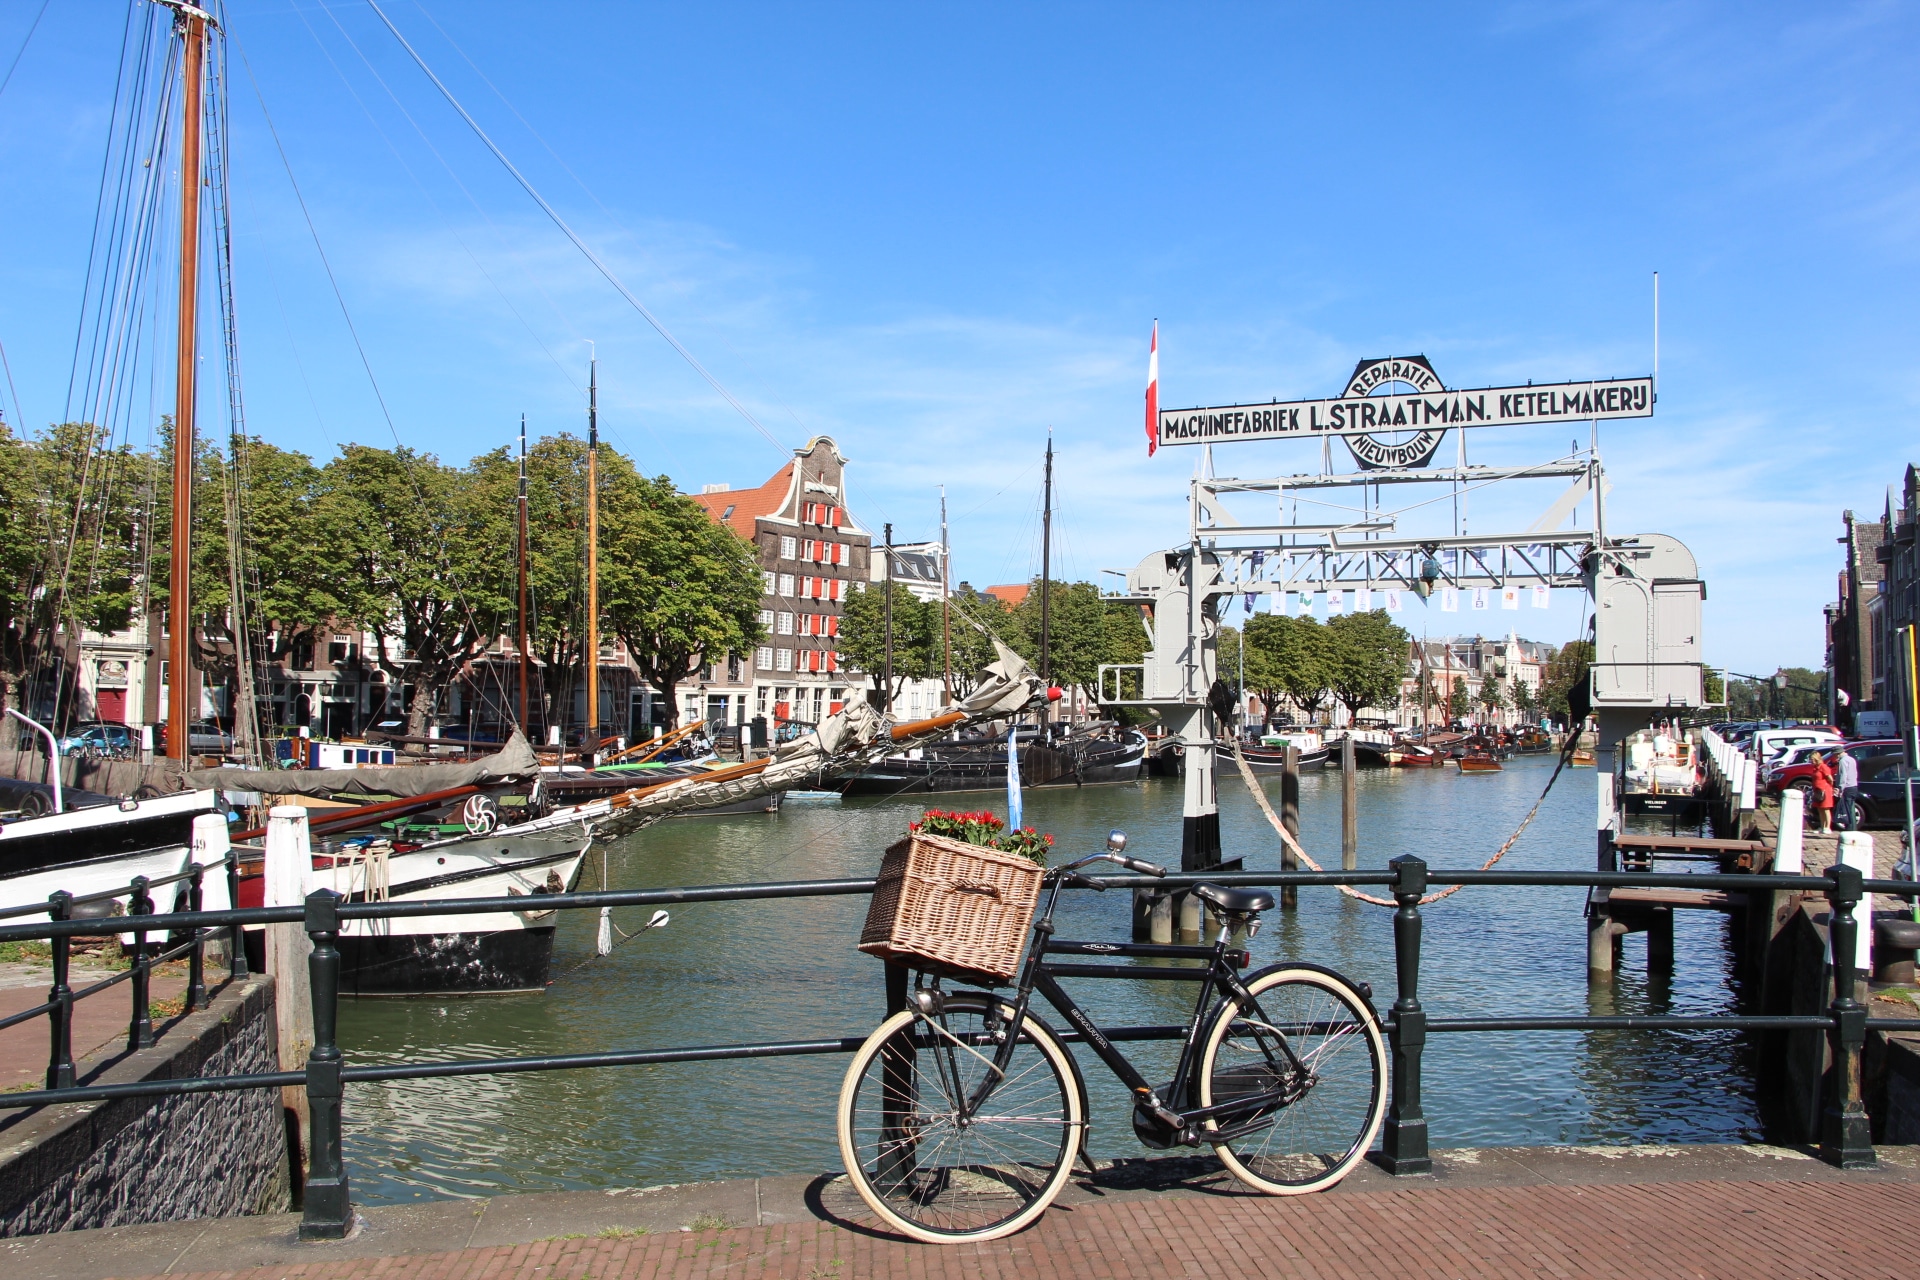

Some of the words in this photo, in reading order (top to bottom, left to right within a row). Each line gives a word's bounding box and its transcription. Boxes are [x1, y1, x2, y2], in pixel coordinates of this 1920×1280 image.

[1351, 362, 1435, 397] REPARATIE
[1165, 408, 1300, 439] MACHINEFABRIEK
[1499, 385, 1647, 418] KETELMAKERIJ
[1352, 431, 1435, 465] NIEUWBOUW
[1070, 1008, 1108, 1049] SPARTA
